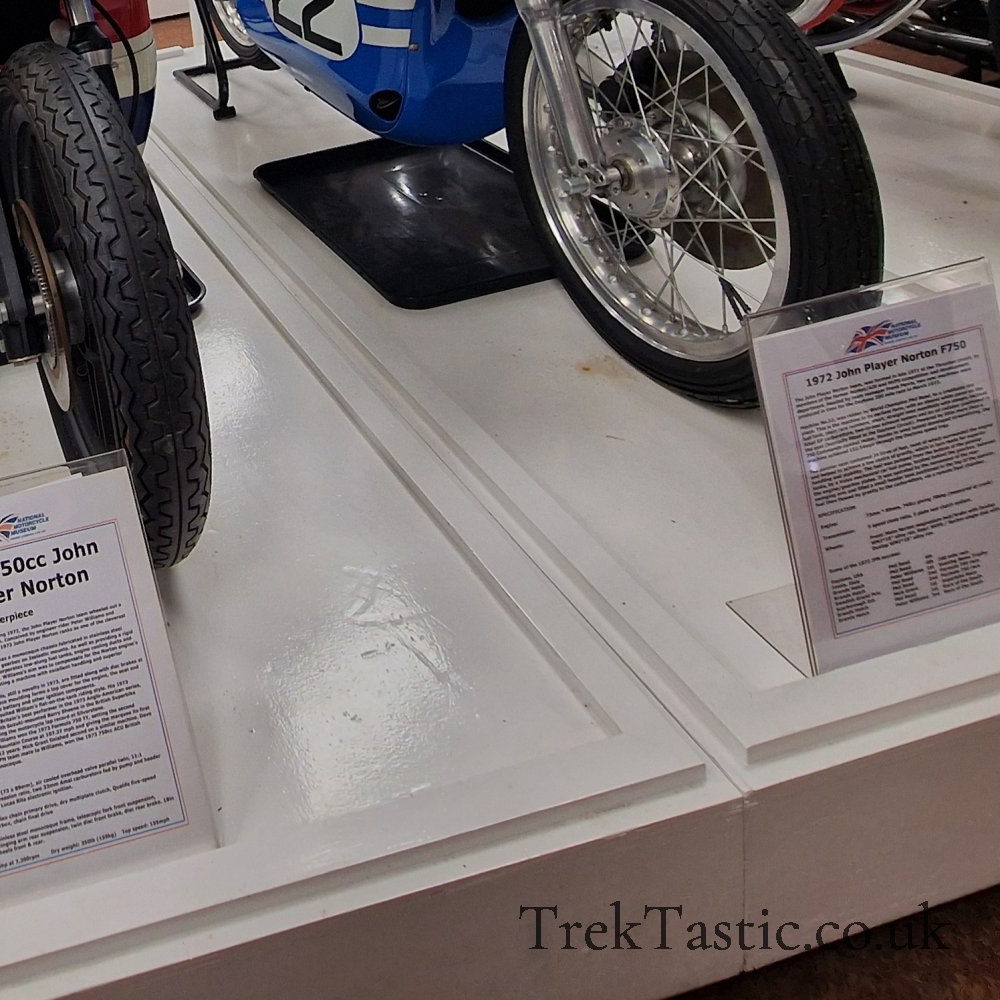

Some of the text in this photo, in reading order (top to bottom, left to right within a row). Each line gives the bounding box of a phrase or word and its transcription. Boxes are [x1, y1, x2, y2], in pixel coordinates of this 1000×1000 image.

[805, 339, 967, 387] 1972 John Player Norton F750
[50, 537, 99, 564] John
[20, 566, 89, 597] Norton
